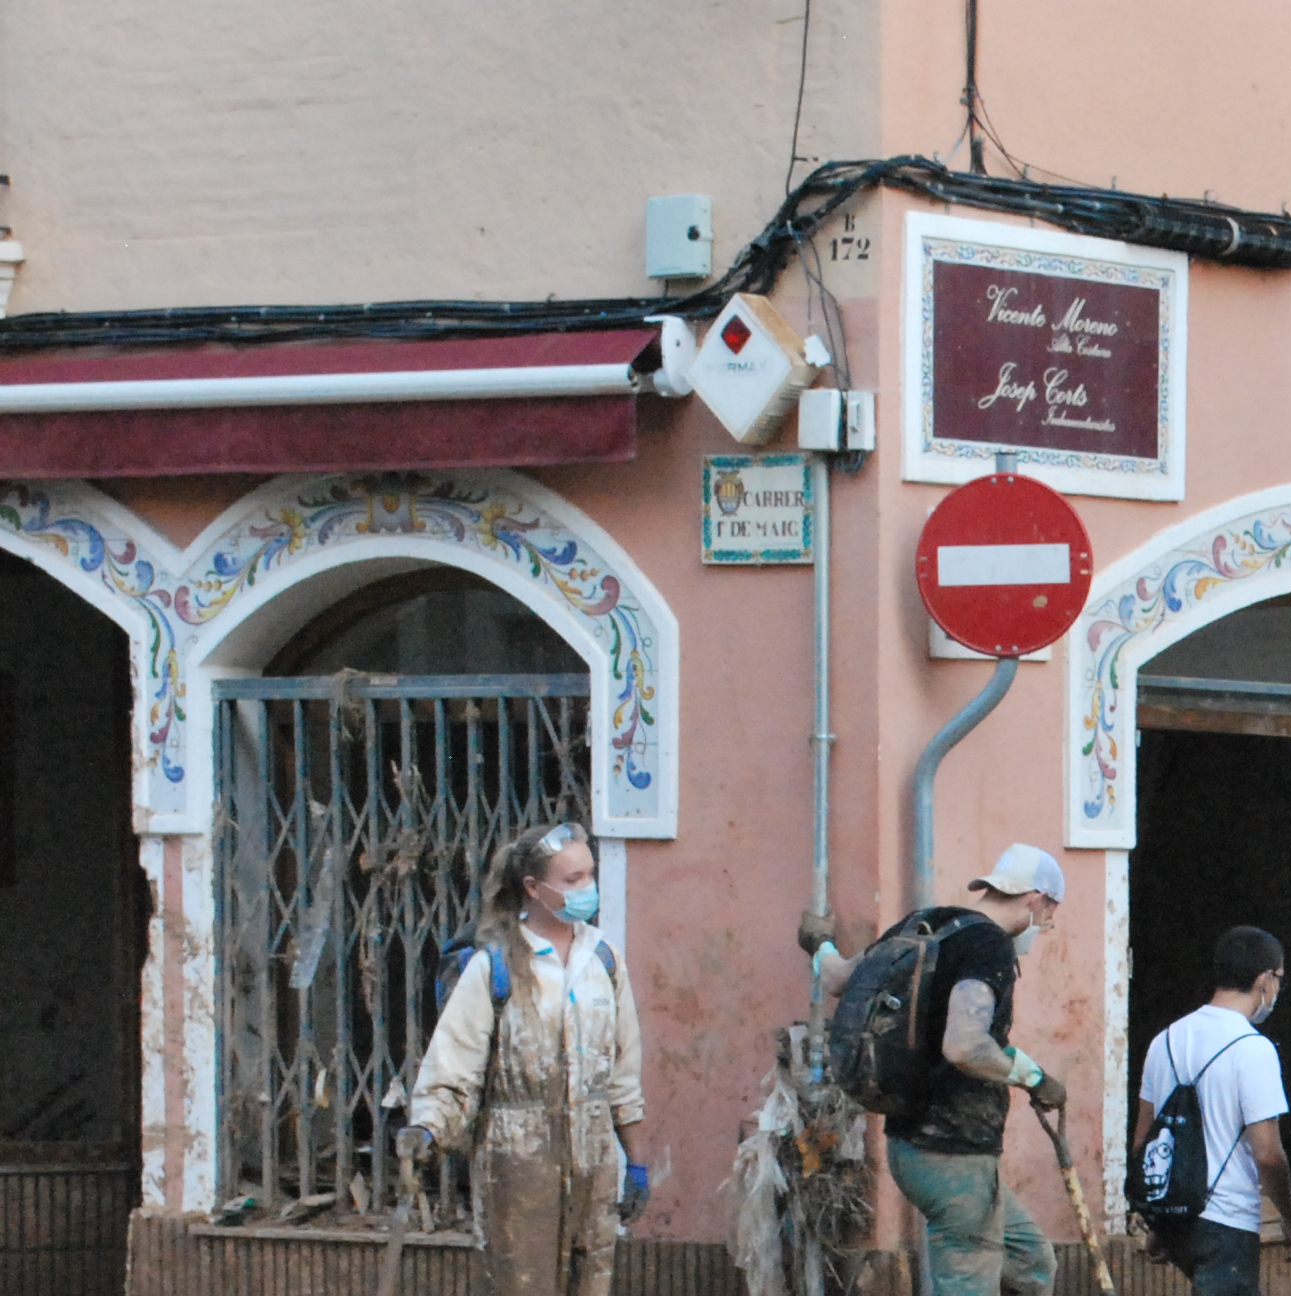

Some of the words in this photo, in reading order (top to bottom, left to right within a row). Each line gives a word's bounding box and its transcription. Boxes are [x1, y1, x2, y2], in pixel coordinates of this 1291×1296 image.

[830, 236, 871, 261] 172
[986, 283, 1047, 328] Vicente
[1051, 296, 1119, 337] Moreno
[977, 361, 1038, 413] Josep
[1043, 366, 1088, 407] Corts
[742, 490, 805, 507] CARRER
[730, 521, 751, 538] DE
[756, 520, 799, 538] MAIG
